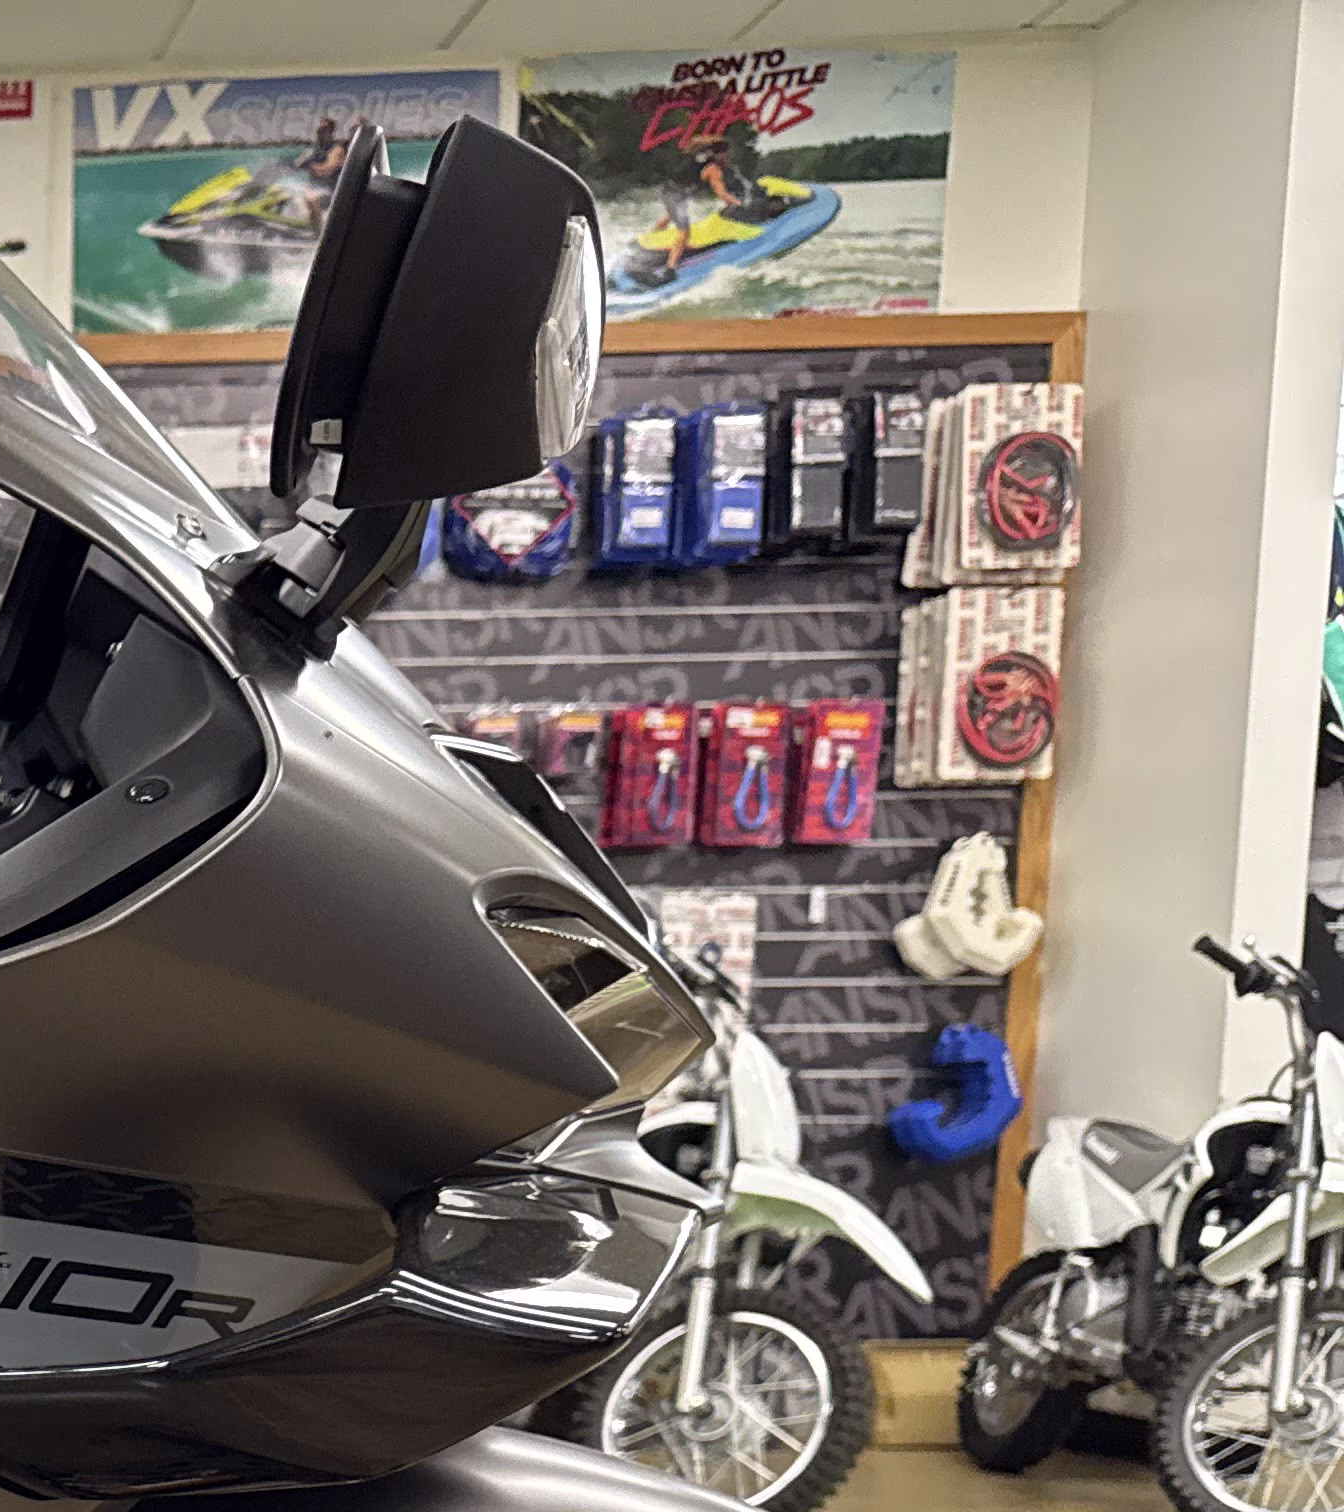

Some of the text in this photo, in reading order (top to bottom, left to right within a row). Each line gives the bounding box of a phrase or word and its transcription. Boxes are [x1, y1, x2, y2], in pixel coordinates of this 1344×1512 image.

[672, 48, 786, 82] BORN TO
[744, 62, 831, 93] LITTLE
[92, 82, 229, 150] VX
[639, 86, 815, 152] CHAOS
